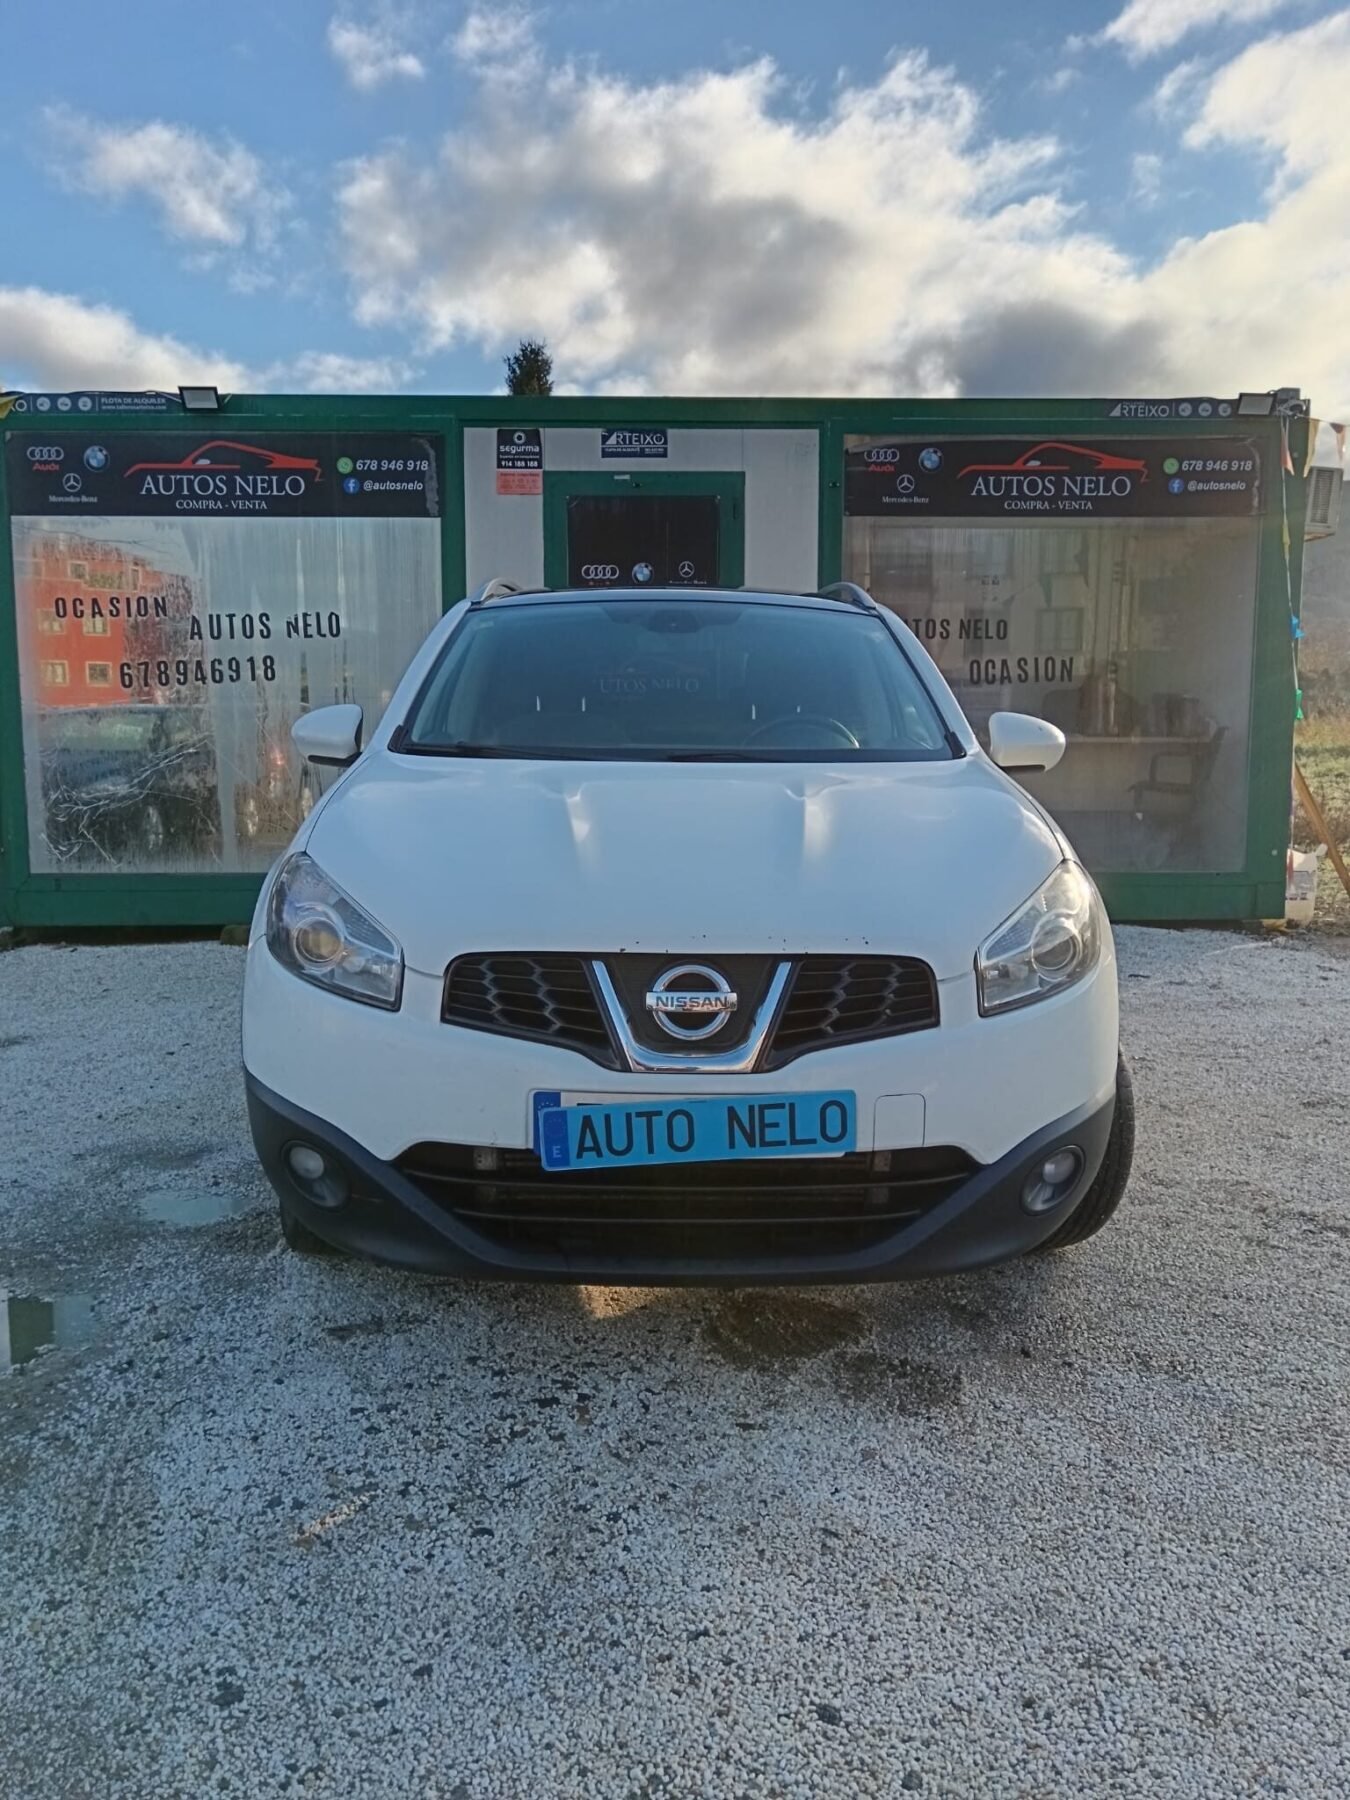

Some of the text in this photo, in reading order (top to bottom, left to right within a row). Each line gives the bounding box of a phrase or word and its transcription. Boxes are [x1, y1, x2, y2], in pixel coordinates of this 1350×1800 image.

[499, 445, 540, 453] segurma
[32, 462, 60, 471] Audi
[356, 459, 429, 471] 678 946 918
[867, 463, 896, 472] Audi
[1181, 460, 1253, 472] 678 946 918
[140, 475, 306, 496] AUTOS NELO
[363, 480, 424, 492] @autosnelo
[970, 475, 1132, 497] AUTOS NELO
[1187, 480, 1246, 492] @autosnelo
[175, 499, 223, 510] COMPRA
[231, 499, 268, 510] VENTA
[881, 495, 929, 504] Mercedes-Benz
[1004, 500, 1050, 511] COMPRA
[1058, 500, 1093, 511] VENTA
[54, 596, 168, 619] OCASION
[189, 611, 341, 641] AUTOS NELO
[904, 618, 1009, 640] TOS NELO
[119, 655, 277, 689] 678946918
[969, 656, 1075, 685] OCASION
[655, 995, 728, 1008] NISSAN
[575, 1100, 849, 1159] AUTO NELO
[552, 1145, 562, 1158] E
